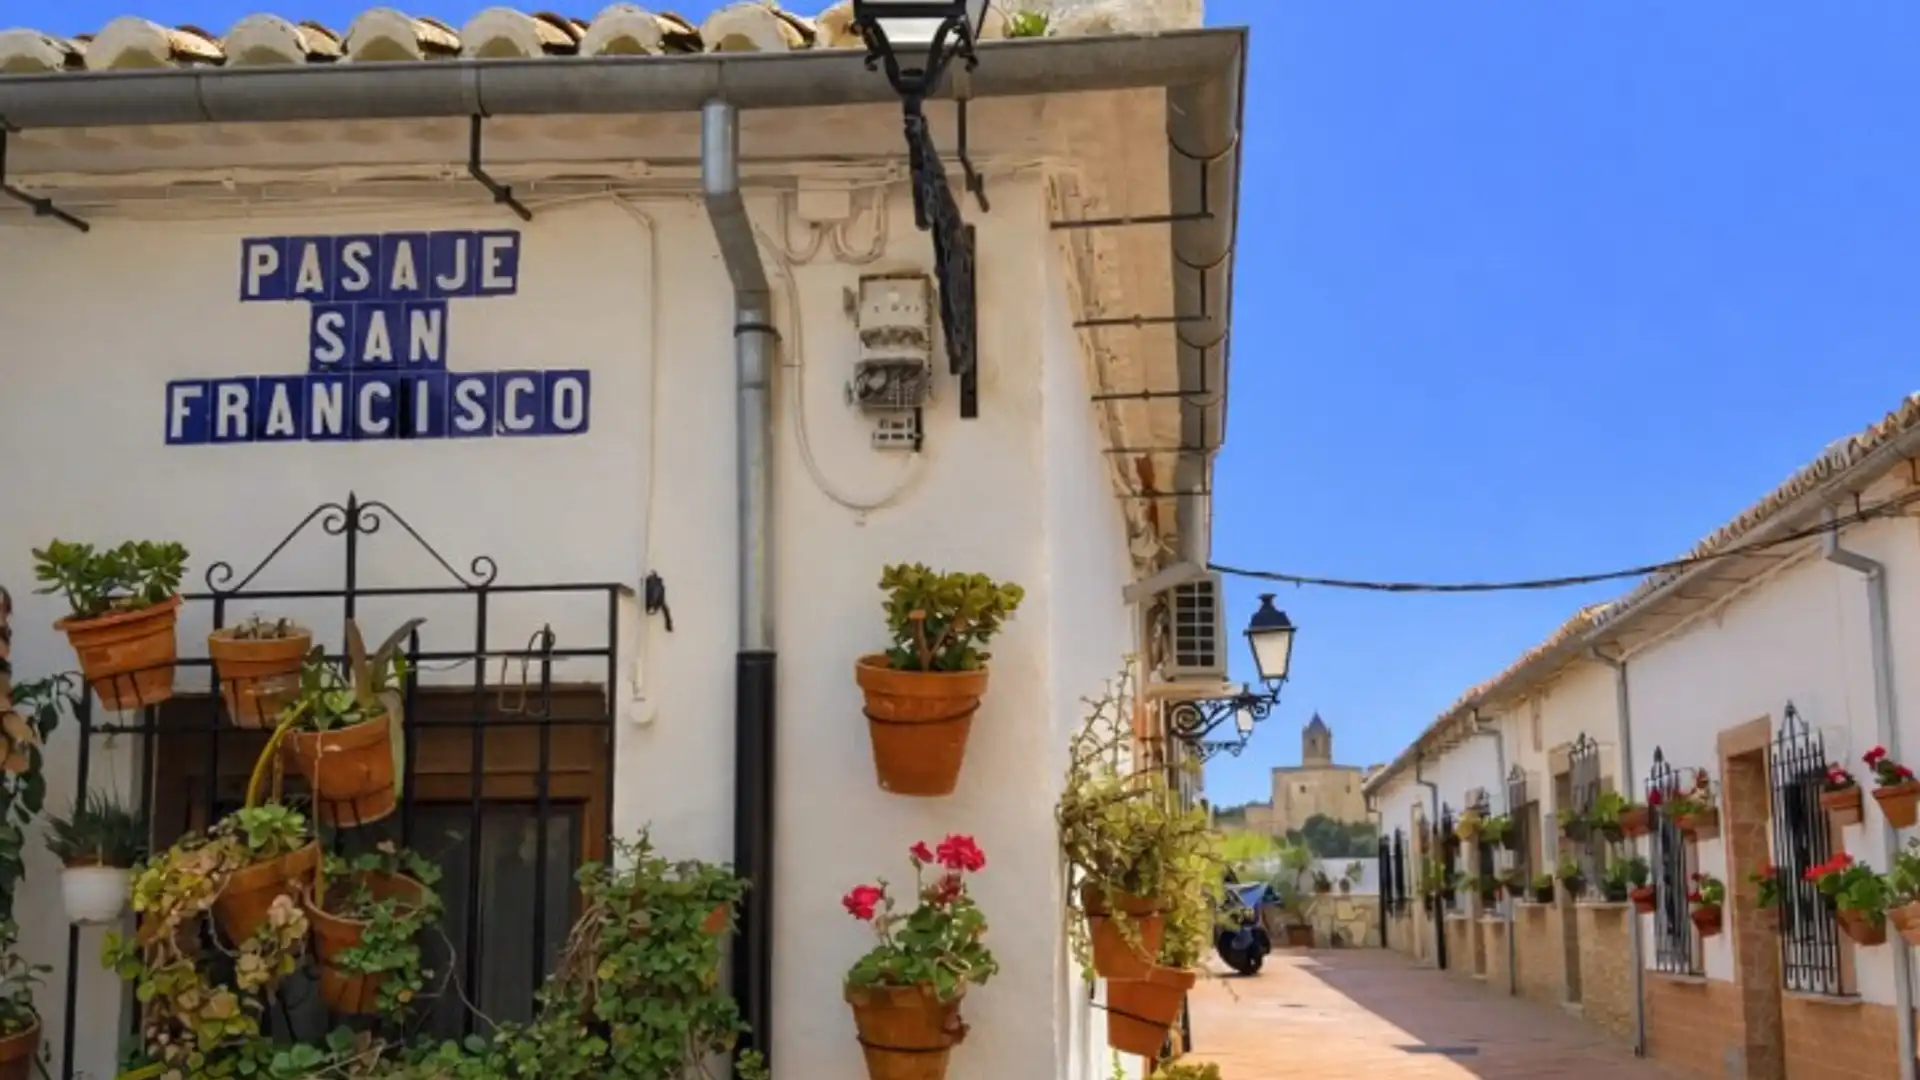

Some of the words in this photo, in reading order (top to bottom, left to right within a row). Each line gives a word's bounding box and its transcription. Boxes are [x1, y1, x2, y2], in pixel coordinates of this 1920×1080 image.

[247, 237, 514, 296] PASAJE
[315, 308, 441, 363] SAN
[170, 376, 584, 439] FRANCISCO
